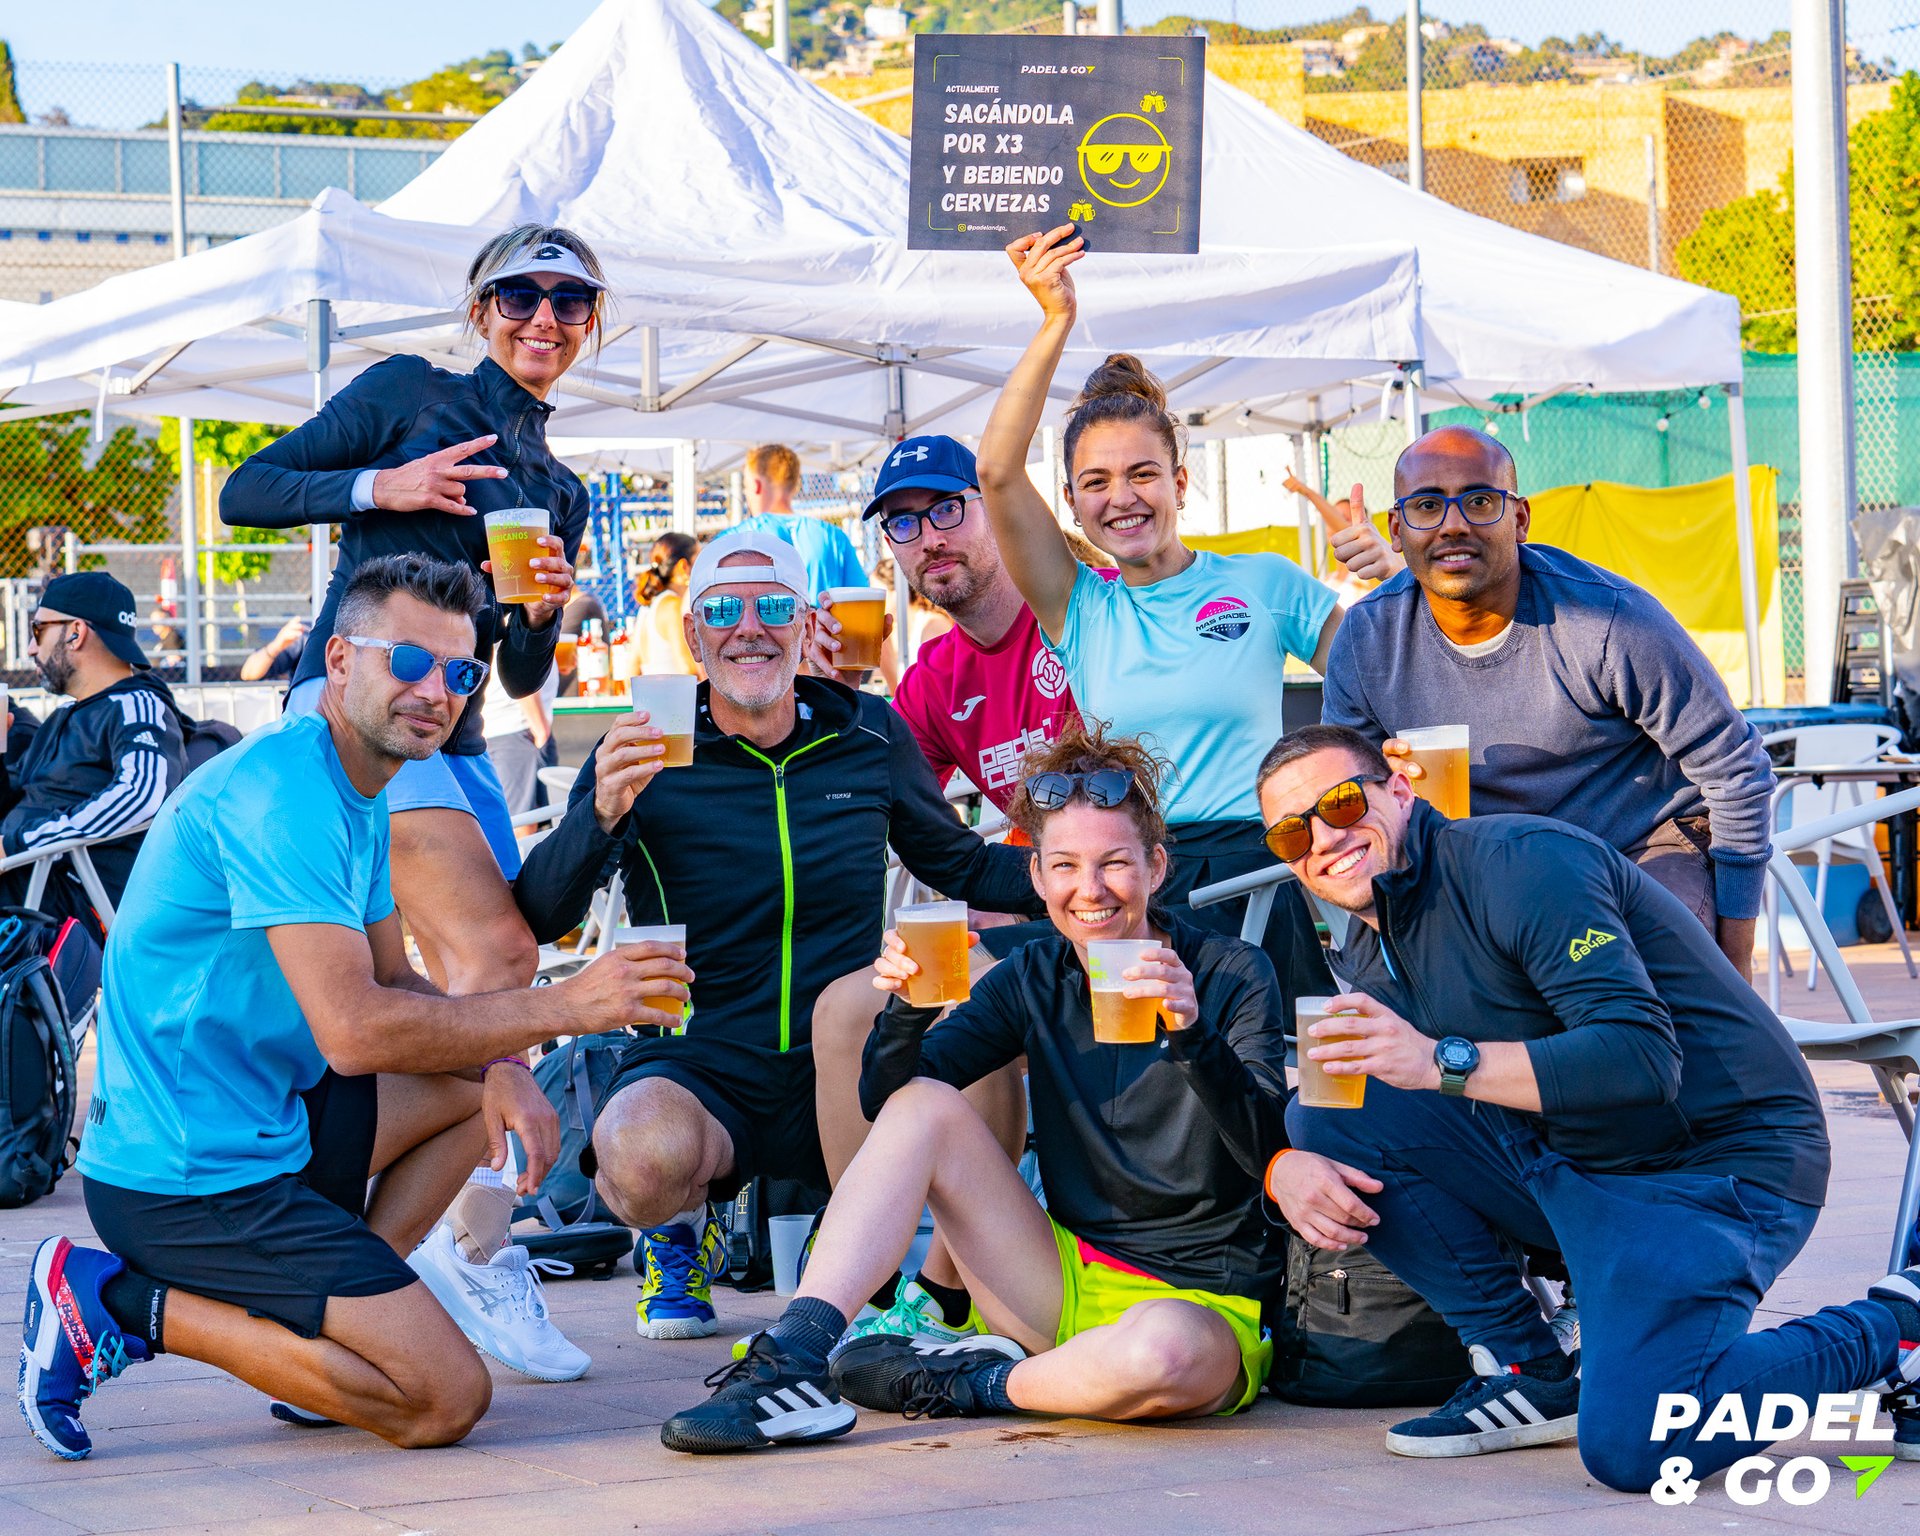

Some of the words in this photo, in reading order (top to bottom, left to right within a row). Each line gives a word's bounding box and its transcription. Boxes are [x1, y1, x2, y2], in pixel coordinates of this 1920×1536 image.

[1020, 65, 1058, 74] PADEL
[1060, 65, 1068, 74] &
[1070, 65, 1086, 74] GO
[945, 85, 999, 93] ACTUALMENTE
[944, 98, 1074, 125] SACÁNDOLA
[943, 133, 986, 153] POR
[995, 134, 1023, 153] X3
[943, 165, 956, 184] Y
[964, 165, 1063, 185] BEBIENDO
[941, 193, 1050, 213] CERVEZAS
[118, 611, 137, 628] adi
[1195, 618, 1217, 632] MAS
[1218, 612, 1251, 620] PADEL
[1570, 935, 1608, 962] 8848
[149, 1288, 161, 1340] HEAD
[927, 1328, 960, 1342] Babolat
